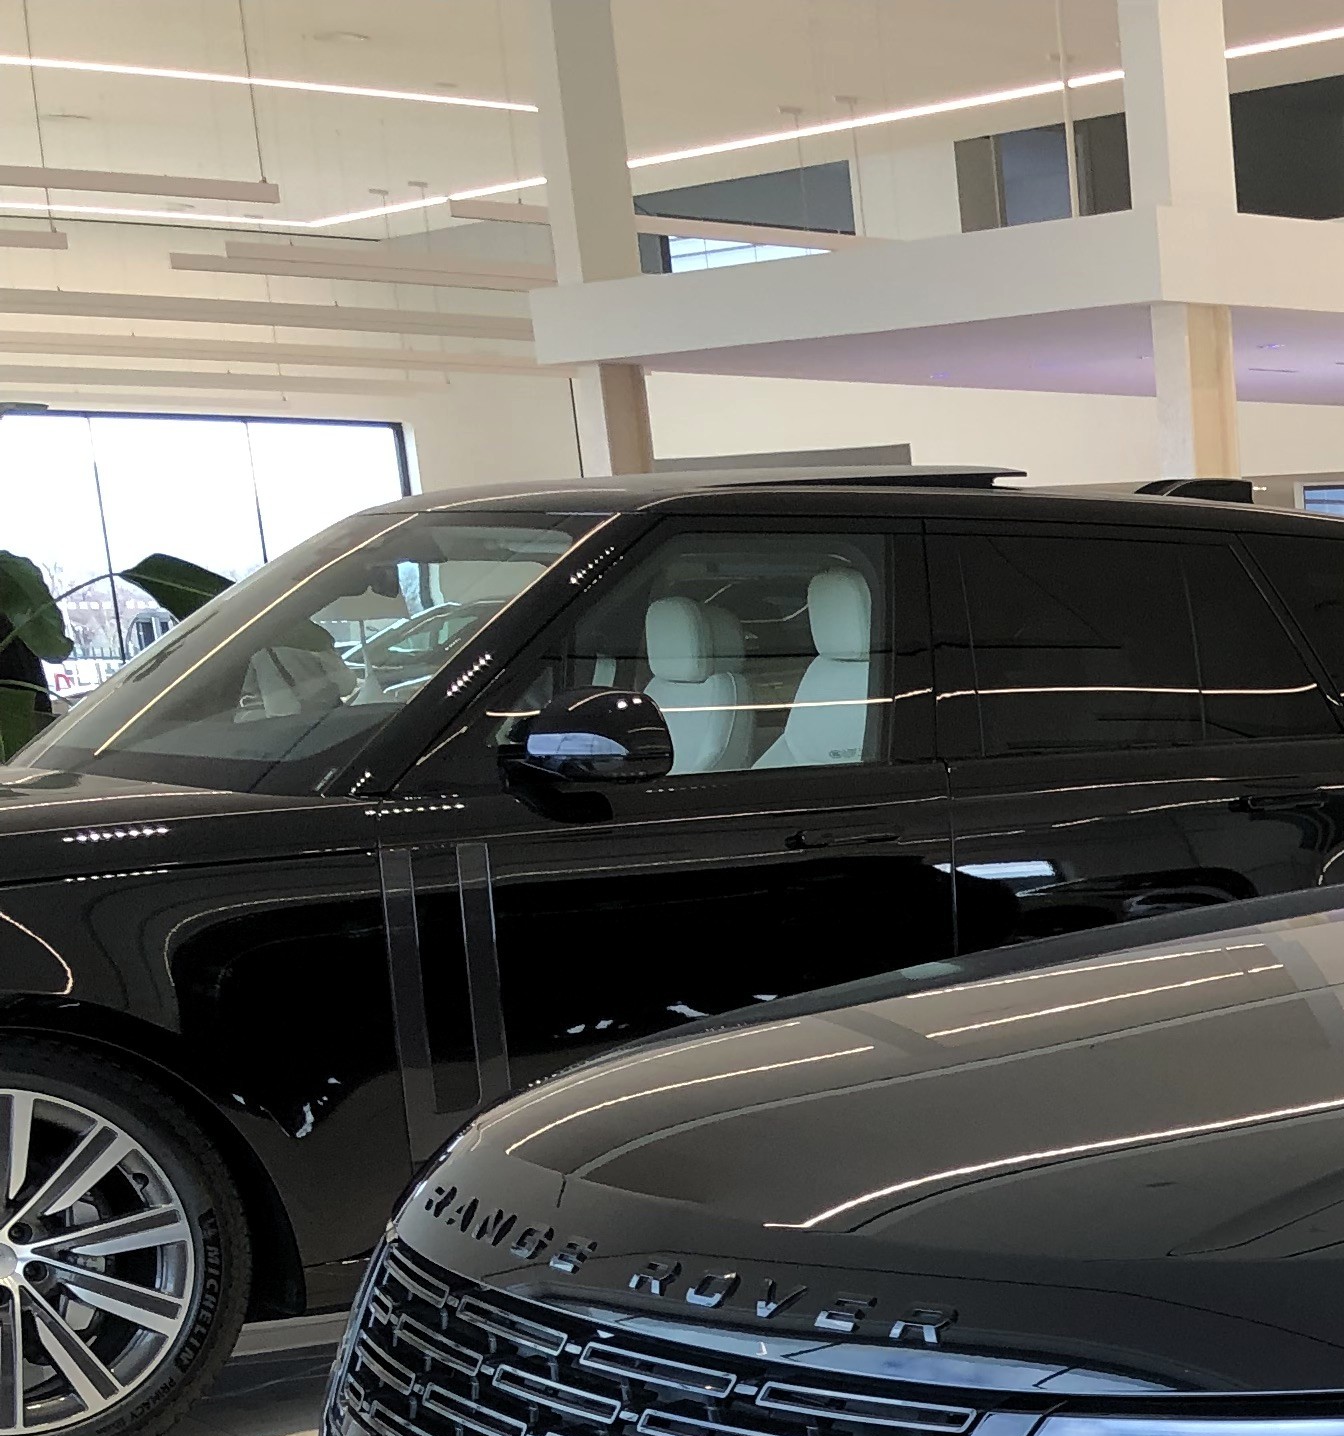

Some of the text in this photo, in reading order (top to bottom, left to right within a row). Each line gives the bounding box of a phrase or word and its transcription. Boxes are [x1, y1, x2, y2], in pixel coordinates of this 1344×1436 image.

[176, 1245, 222, 1369] MICHELIN
[424, 1184, 960, 1345] RANGE ROVER
